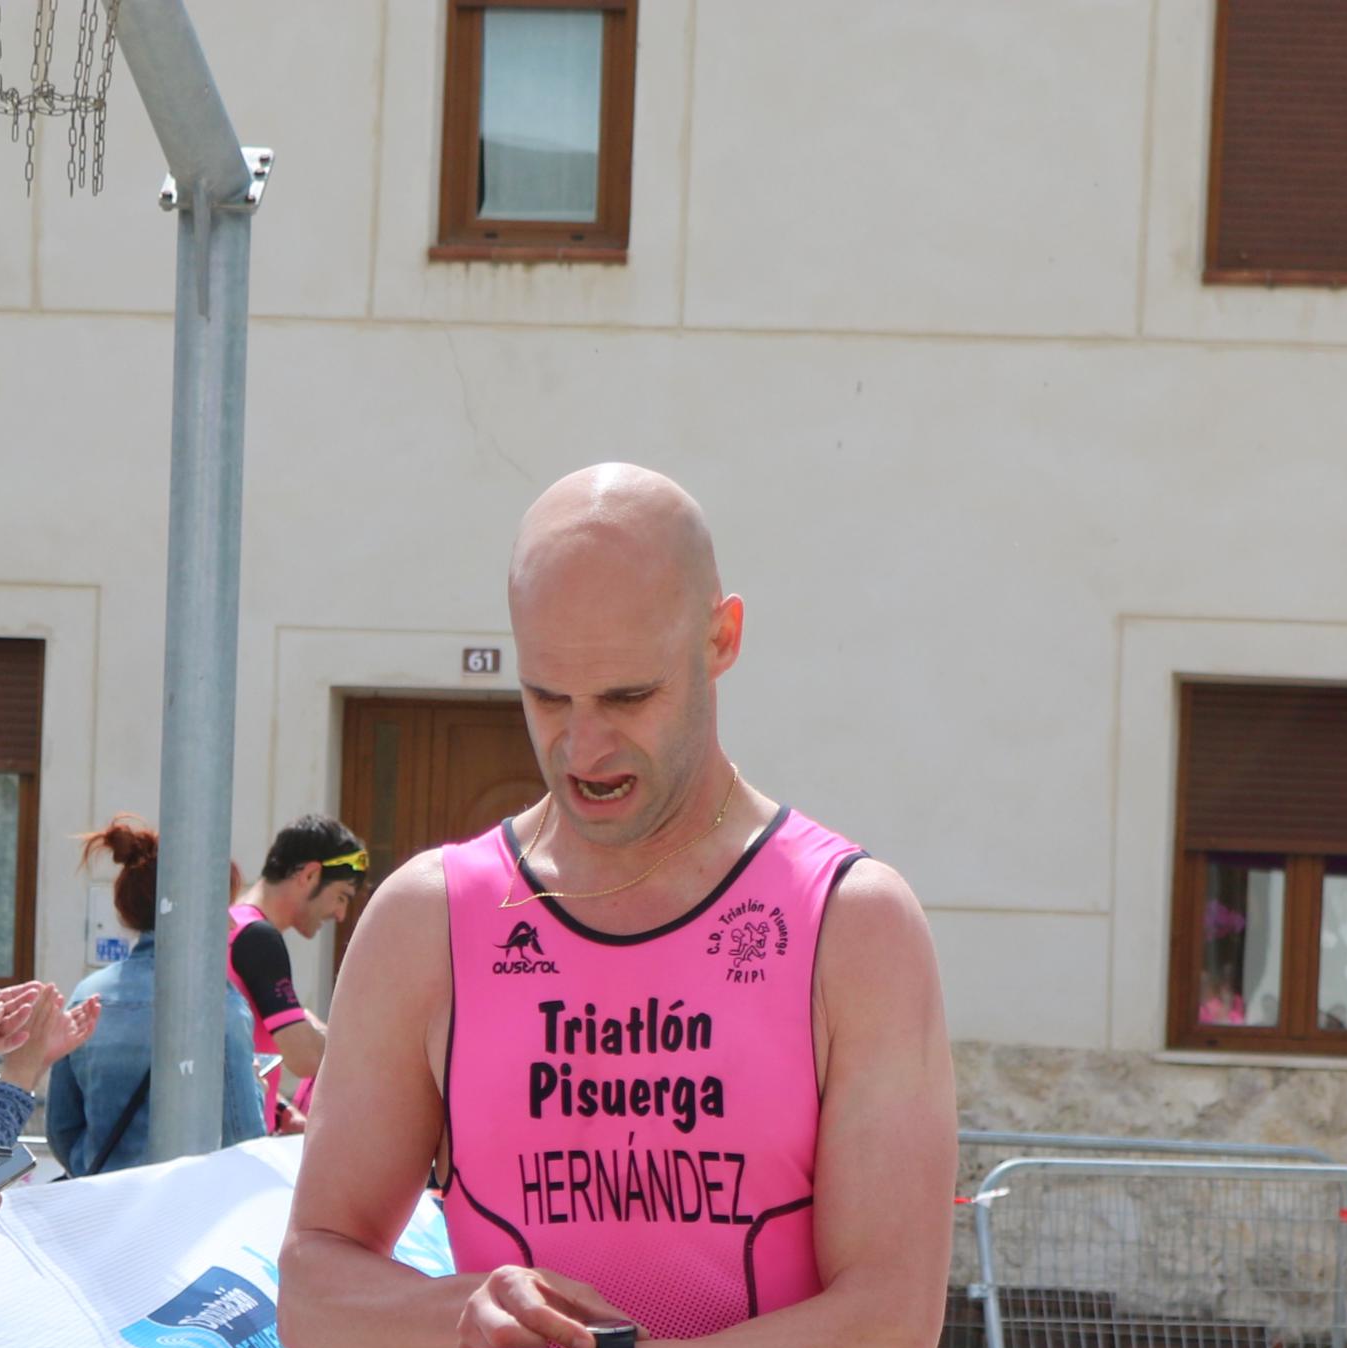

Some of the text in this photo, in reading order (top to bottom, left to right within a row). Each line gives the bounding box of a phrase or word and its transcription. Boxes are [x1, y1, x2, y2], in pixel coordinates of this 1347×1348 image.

[467, 650, 494, 672] 61
[725, 968, 765, 984] TRIPI
[538, 997, 713, 1056] Triatlón
[529, 1061, 725, 1134] Pisuerga
[518, 1131, 754, 1226] HERNÁNDEZ
